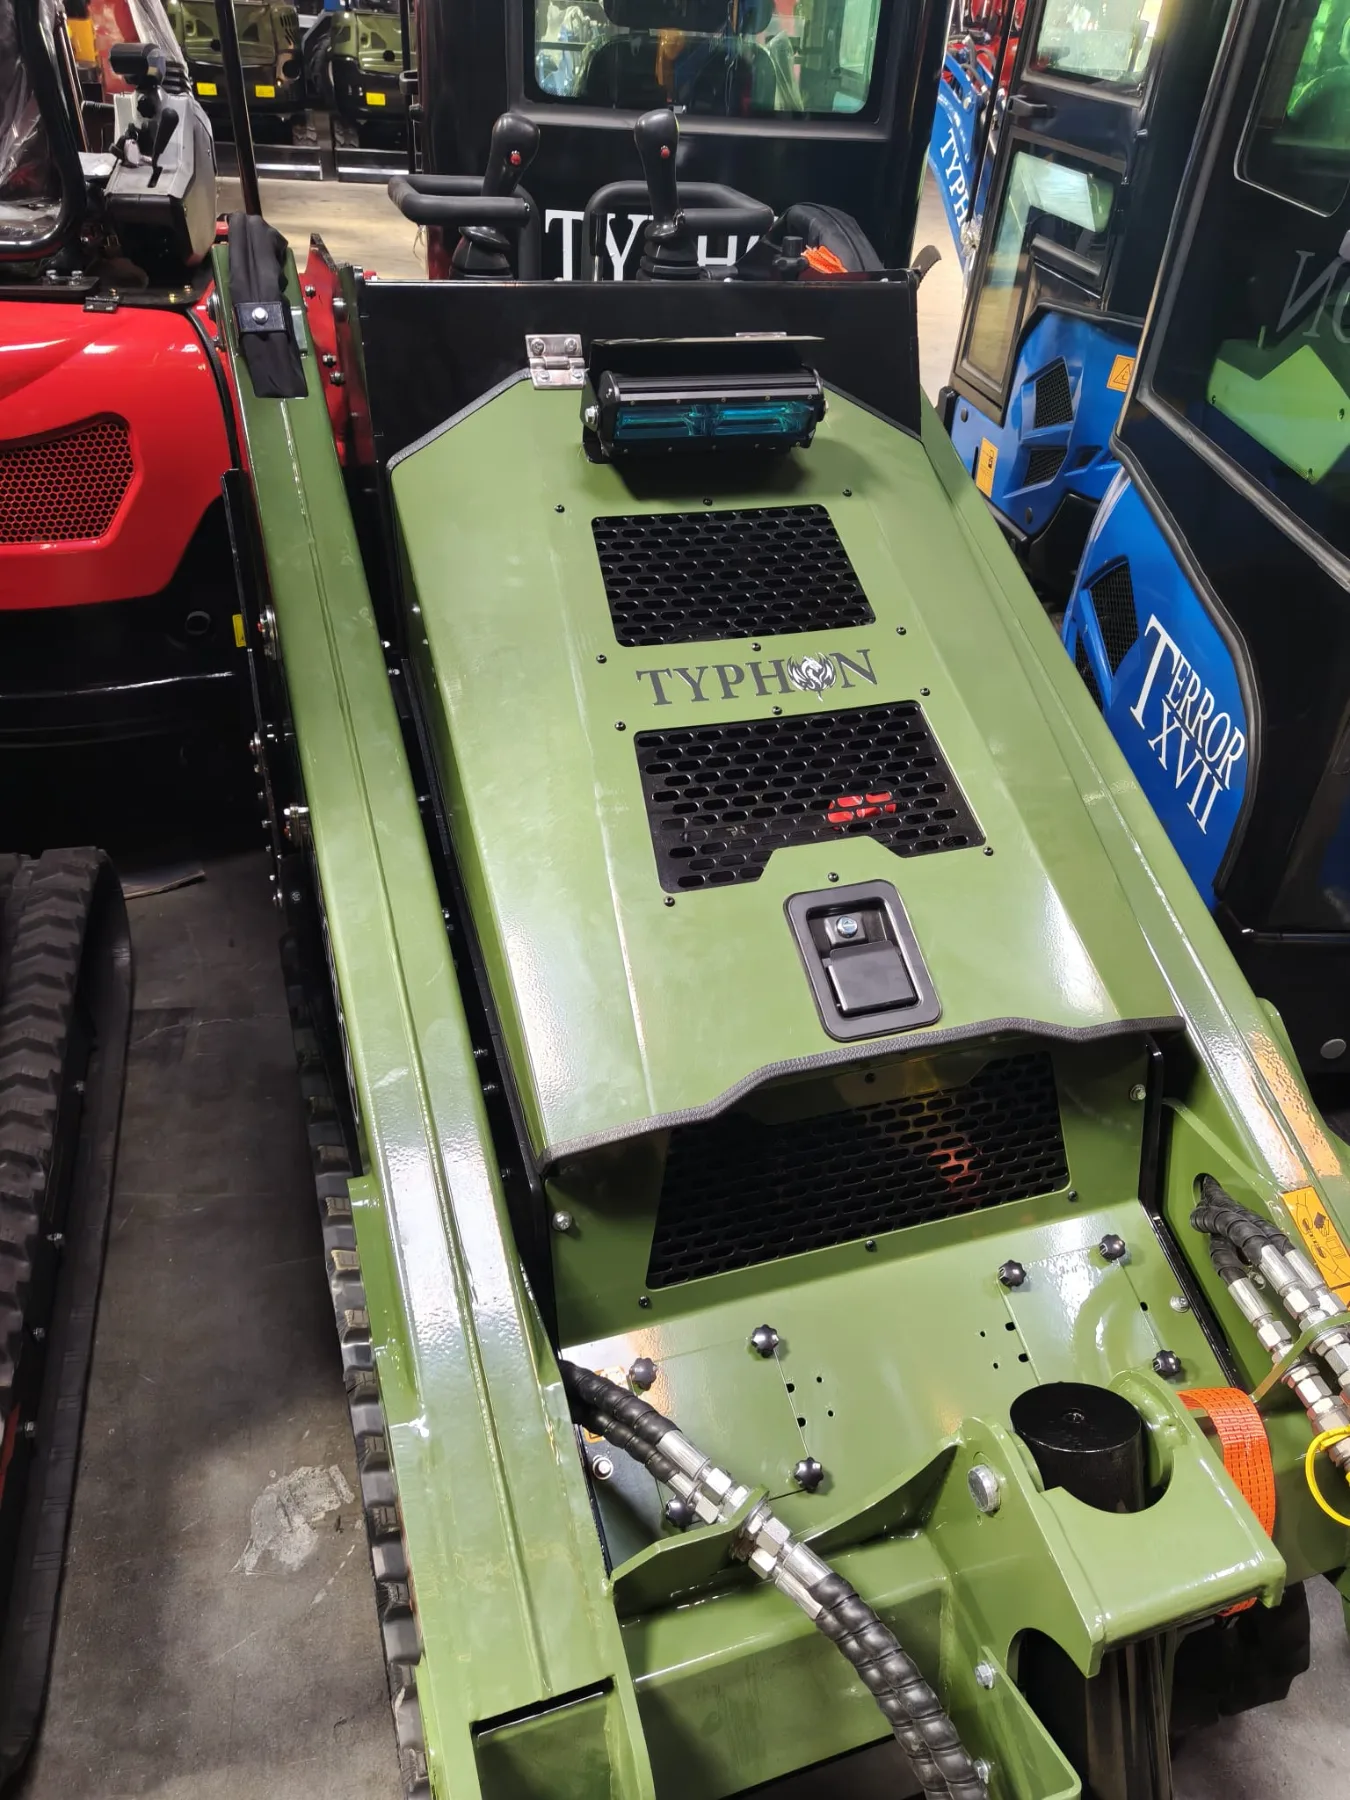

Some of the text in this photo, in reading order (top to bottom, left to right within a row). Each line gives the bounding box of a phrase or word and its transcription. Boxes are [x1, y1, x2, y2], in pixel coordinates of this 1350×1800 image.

[939, 127, 970, 227] TYPH
[635, 649, 878, 706] TYPHON
[1130, 614, 1245, 790] TERROR
[1148, 697, 1223, 834] XVII
